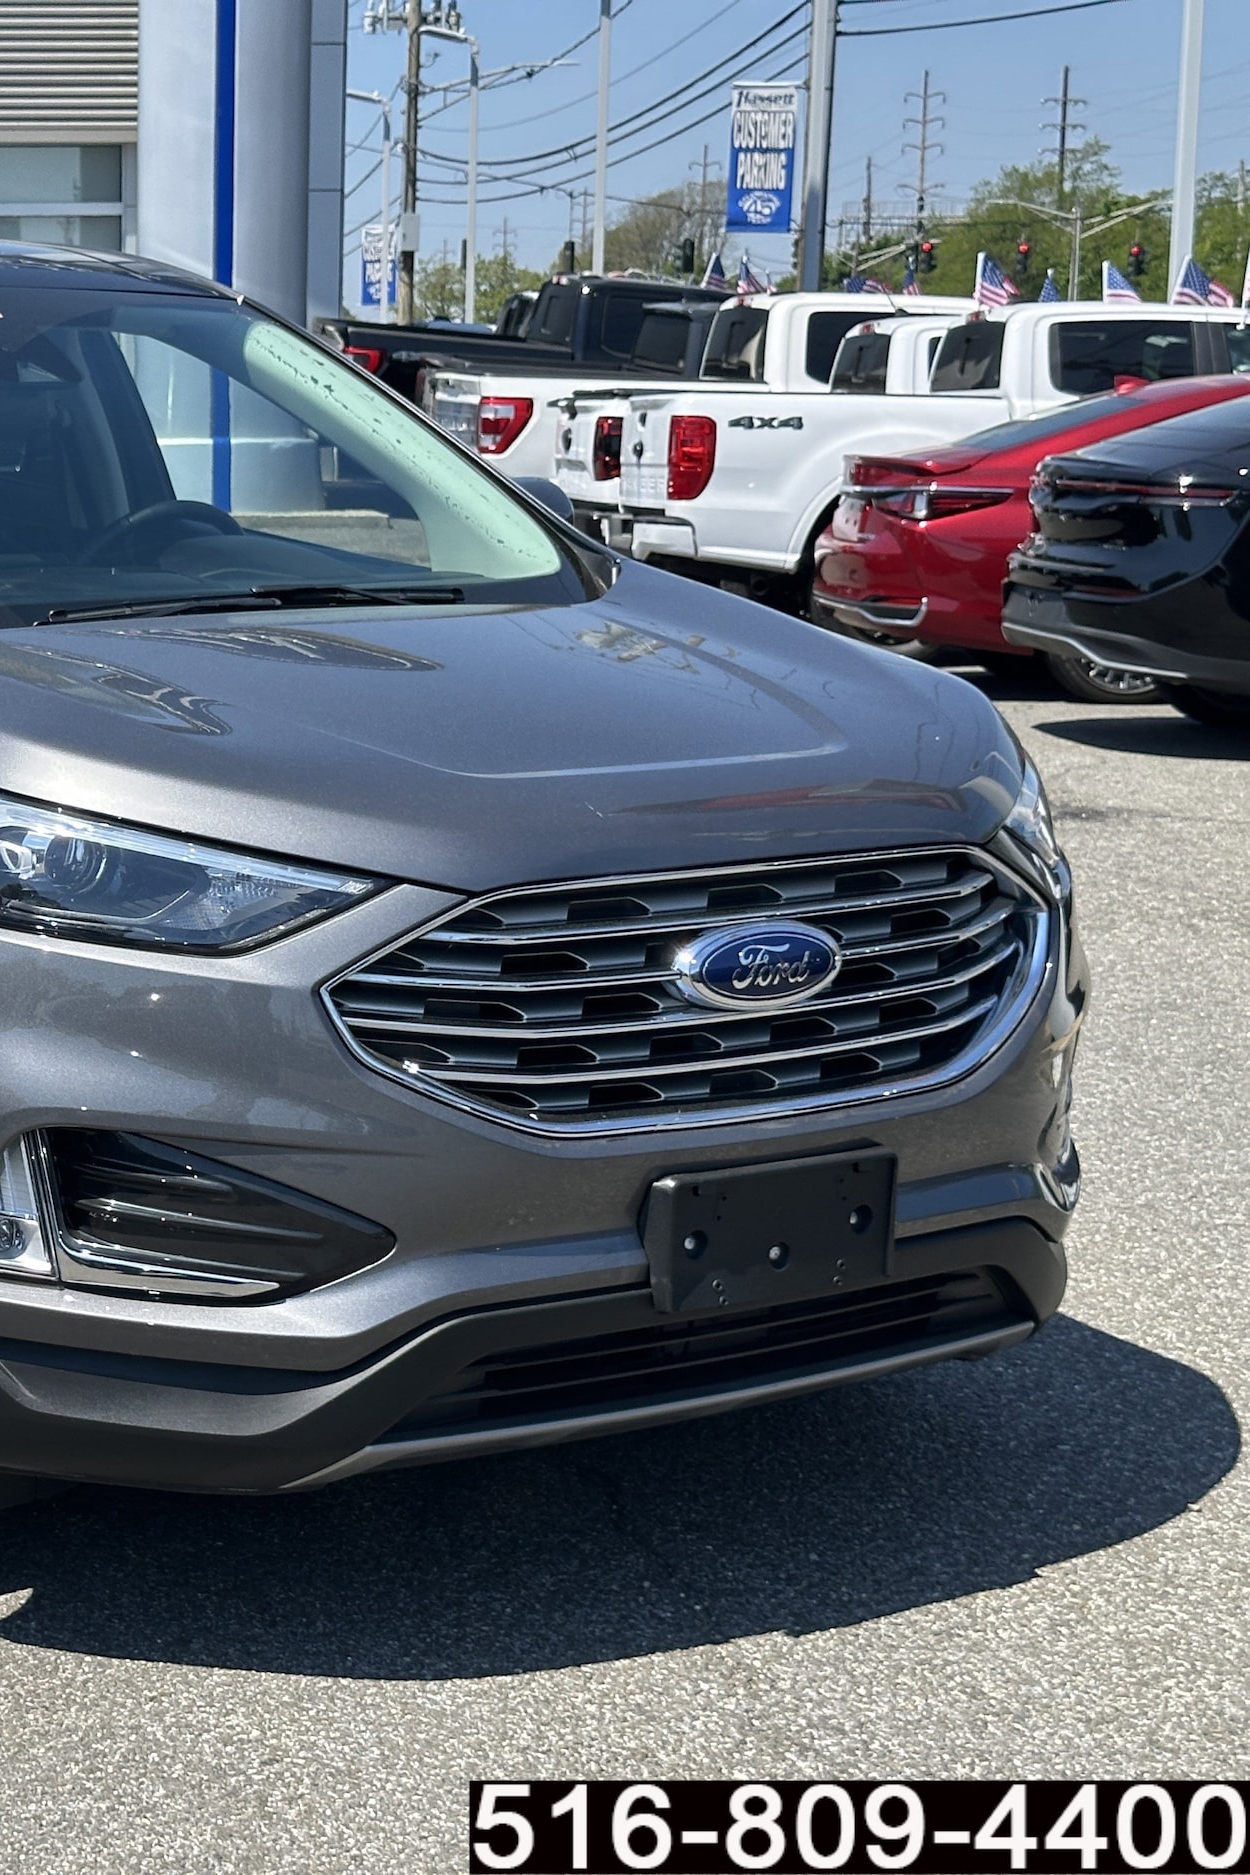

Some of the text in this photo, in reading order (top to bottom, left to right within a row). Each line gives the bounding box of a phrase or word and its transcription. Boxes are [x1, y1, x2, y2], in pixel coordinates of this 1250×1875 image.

[733, 111, 794, 149] CUSTOMER
[736, 152, 786, 190] PARKING
[732, 943, 810, 989] Ford
